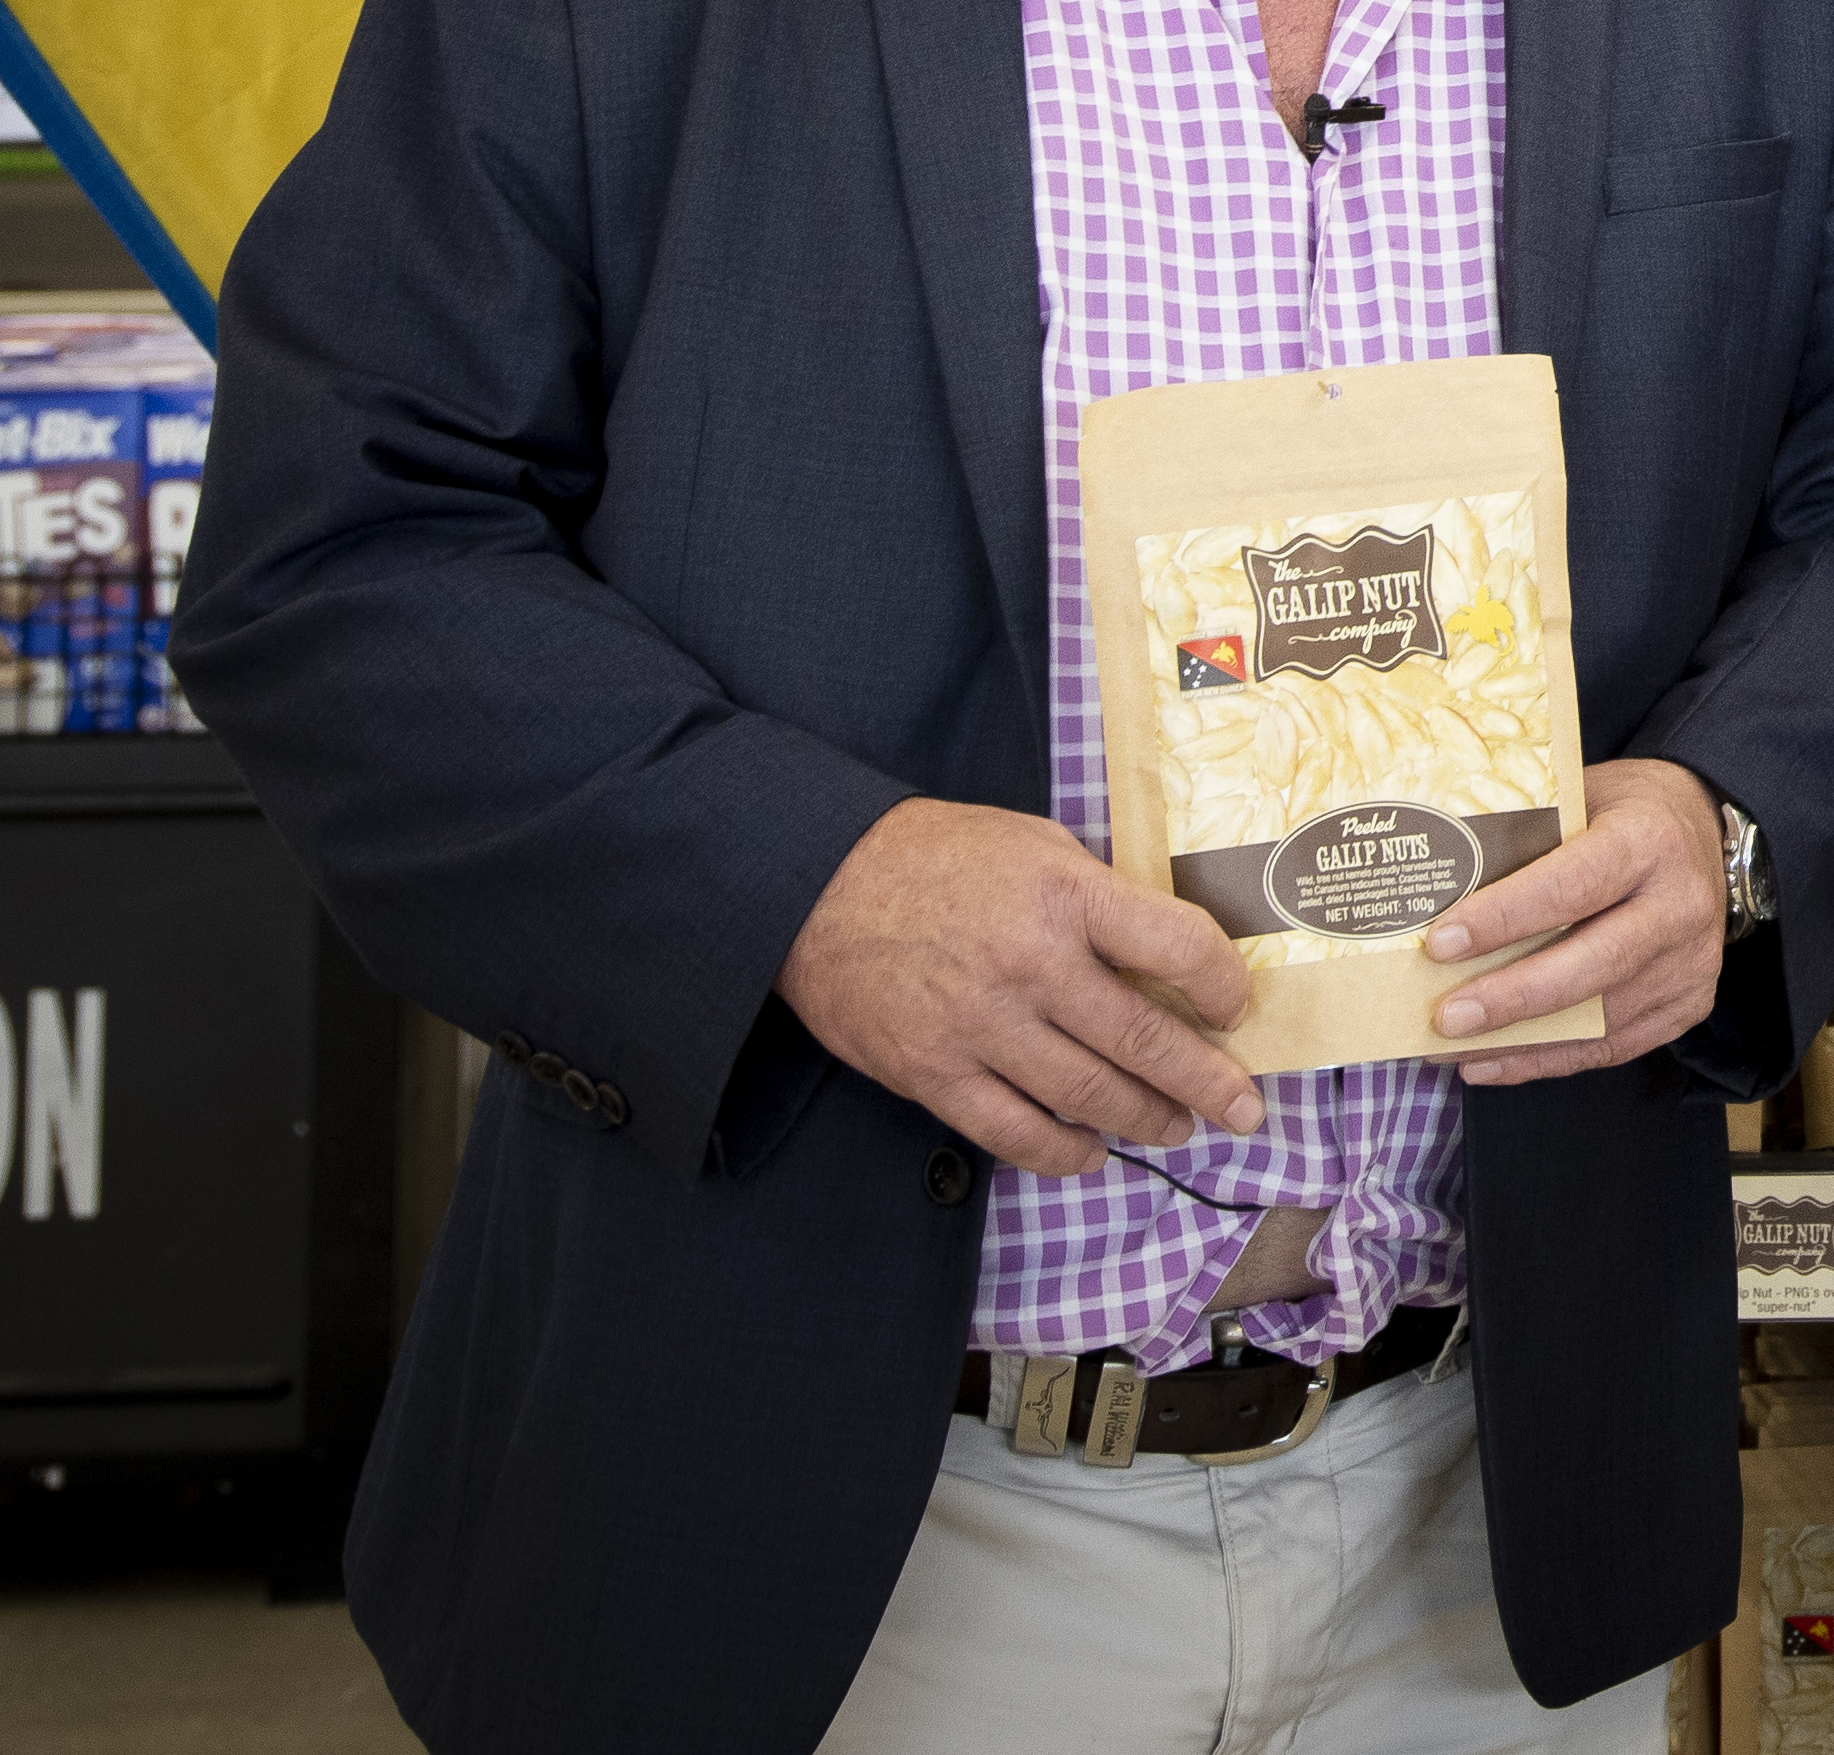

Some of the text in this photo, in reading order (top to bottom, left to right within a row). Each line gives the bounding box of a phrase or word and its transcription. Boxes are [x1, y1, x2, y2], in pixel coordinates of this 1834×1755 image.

[1267, 570, 1421, 626] GALIP NUT
[1329, 609, 1418, 654] company
[1340, 810, 1398, 838] Peeled
[1316, 833, 1431, 872] GALIP NUTS
[1325, 897, 1435, 923] NET WEIGHT: 100g
[1744, 1223, 1832, 1244] GALIP NUT
[1753, 1287, 1773, 1298] Nut
[1785, 1287, 1819, 1298] PNG's
